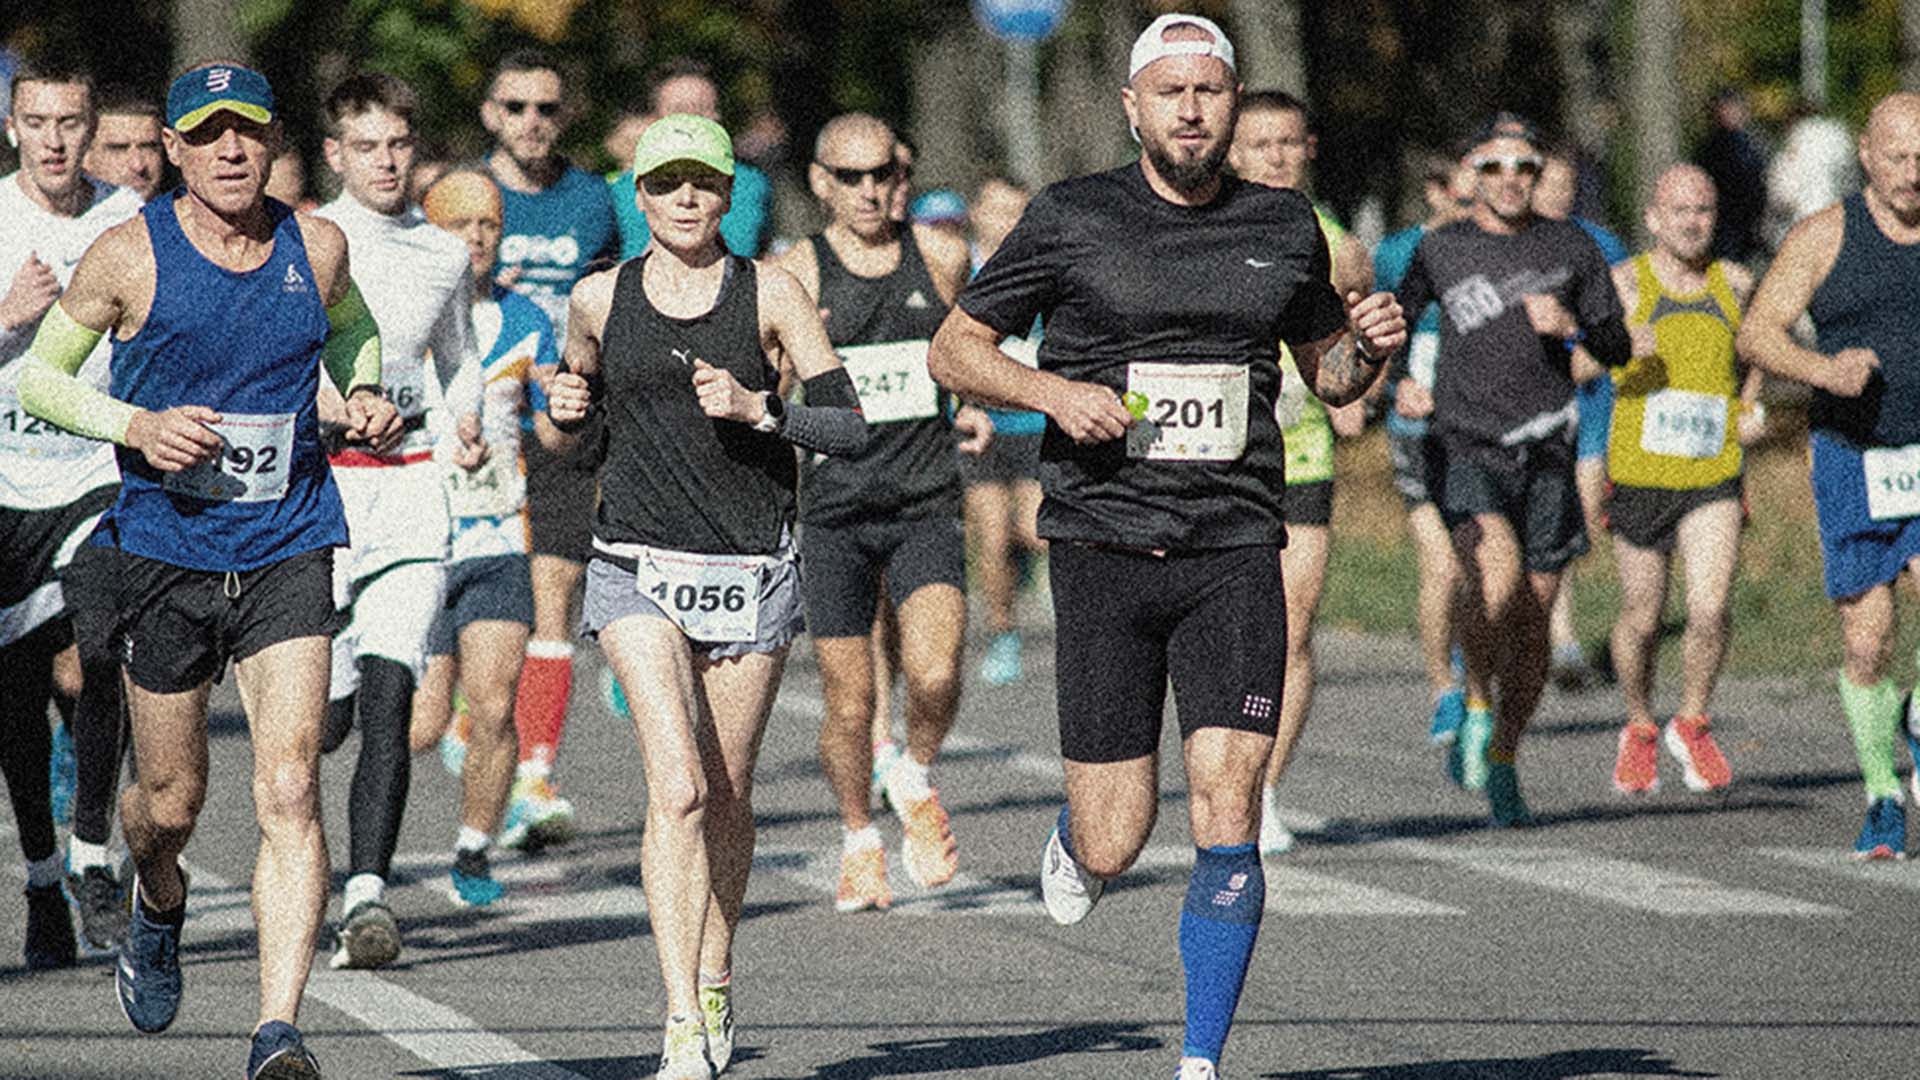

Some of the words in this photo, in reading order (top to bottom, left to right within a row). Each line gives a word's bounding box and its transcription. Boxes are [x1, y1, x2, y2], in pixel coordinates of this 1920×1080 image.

[856, 370, 909, 397] 247
[1154, 398, 1223, 429] 201
[1882, 469, 1920, 493] 10
[650, 581, 746, 613] 1056
